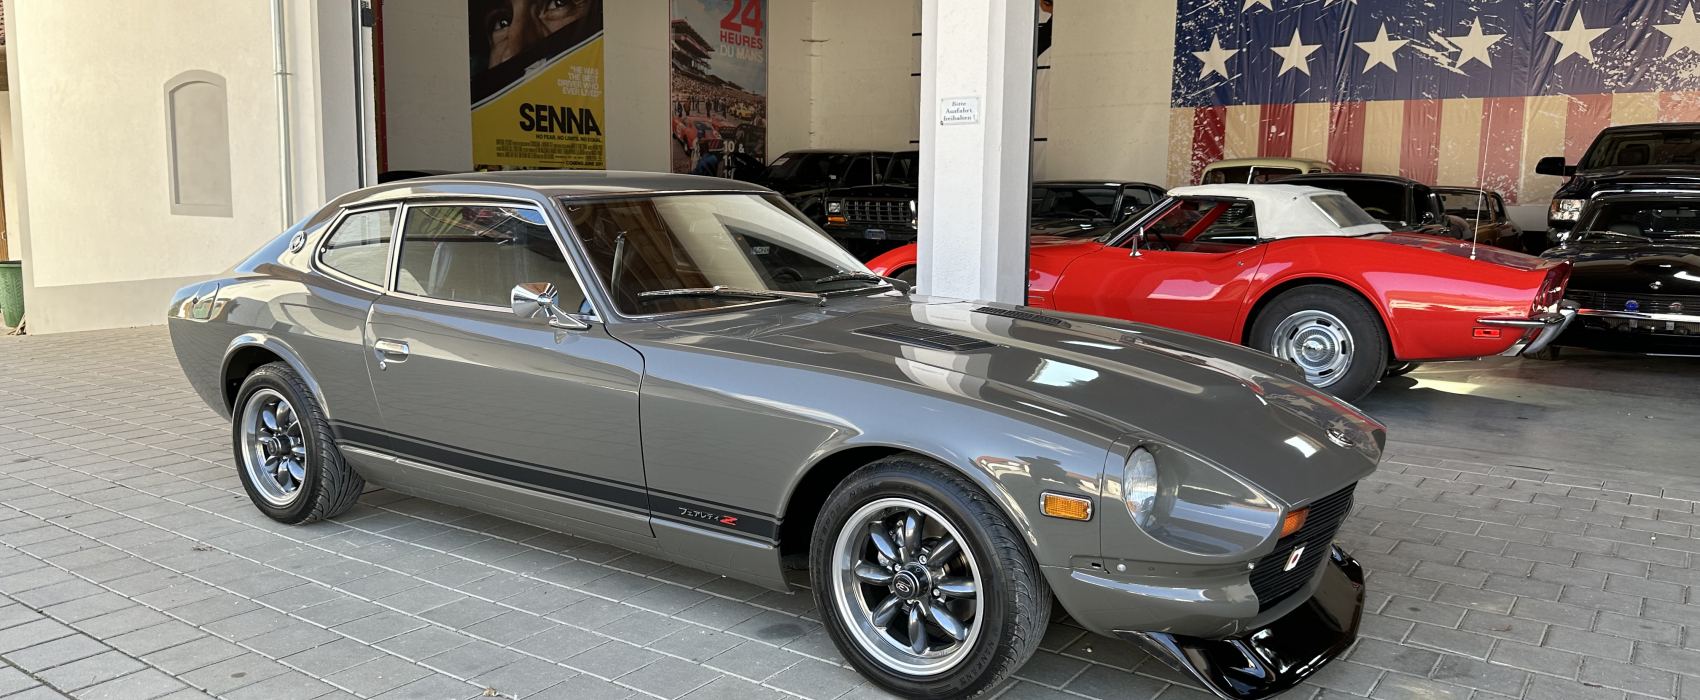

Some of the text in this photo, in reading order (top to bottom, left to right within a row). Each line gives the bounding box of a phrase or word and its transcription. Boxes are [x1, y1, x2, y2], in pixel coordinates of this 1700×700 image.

[720, 0, 763, 36] 24
[720, 30, 763, 50] HEURES
[720, 44, 763, 63] DU MANS
[582, 74, 599, 82] BEST
[584, 67, 598, 76] WAS
[558, 79, 599, 90] DRIVER WHO
[562, 87, 580, 95] EVER
[519, 103, 602, 136] SENNA
[723, 140, 745, 153] 10 &
